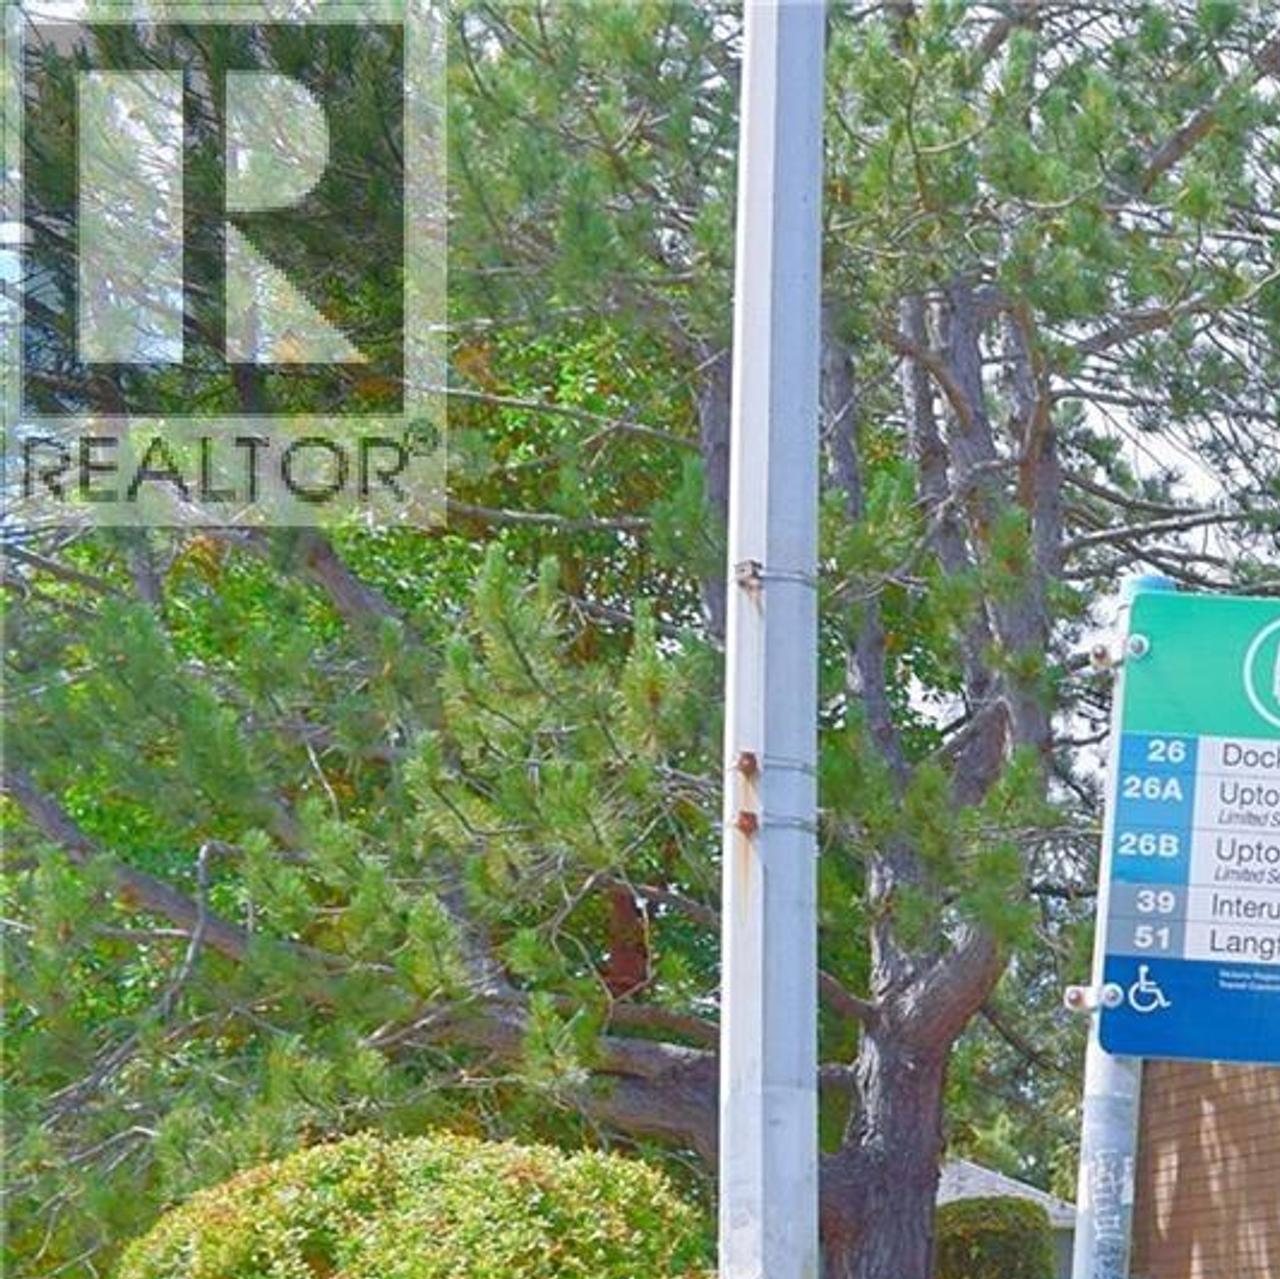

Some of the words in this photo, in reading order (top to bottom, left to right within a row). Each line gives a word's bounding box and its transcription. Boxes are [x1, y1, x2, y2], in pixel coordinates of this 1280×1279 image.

[1147, 739, 1187, 763] 26
[1123, 775, 1184, 801] 26A
[1217, 809, 1269, 827] Limited
[1117, 832, 1180, 857] 26B
[1213, 865, 1266, 884] Limited
[1136, 890, 1176, 914] 39
[1133, 925, 1170, 949] 51
